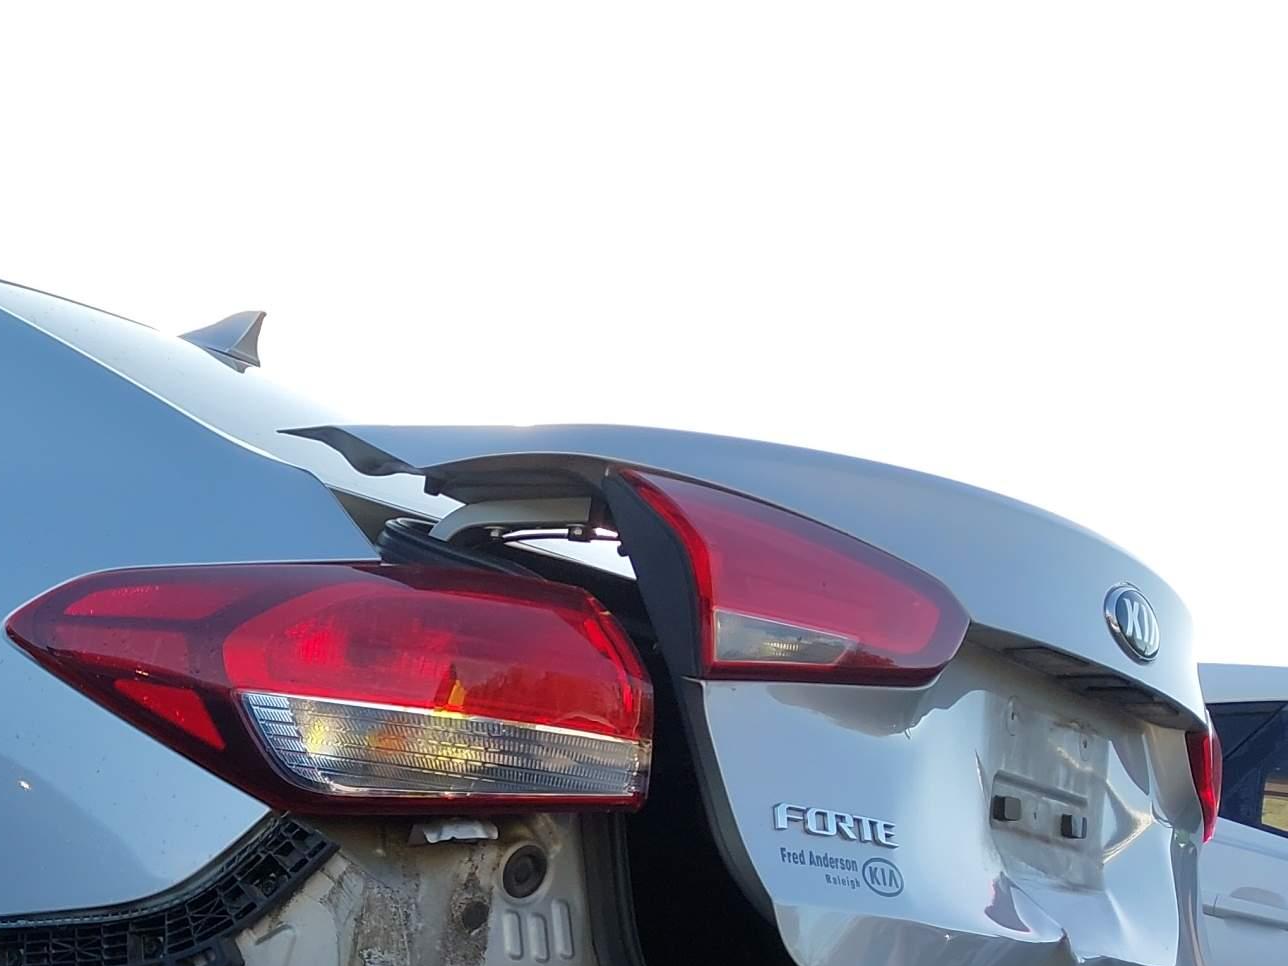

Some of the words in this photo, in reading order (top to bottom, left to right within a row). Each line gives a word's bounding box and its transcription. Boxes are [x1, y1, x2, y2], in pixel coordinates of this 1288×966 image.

[773, 802, 900, 849] FORTE
[780, 847, 806, 865] Fred
[809, 850, 859, 873] Anderson
[825, 873, 861, 890] Raleigh
[868, 865, 900, 890] KIA
